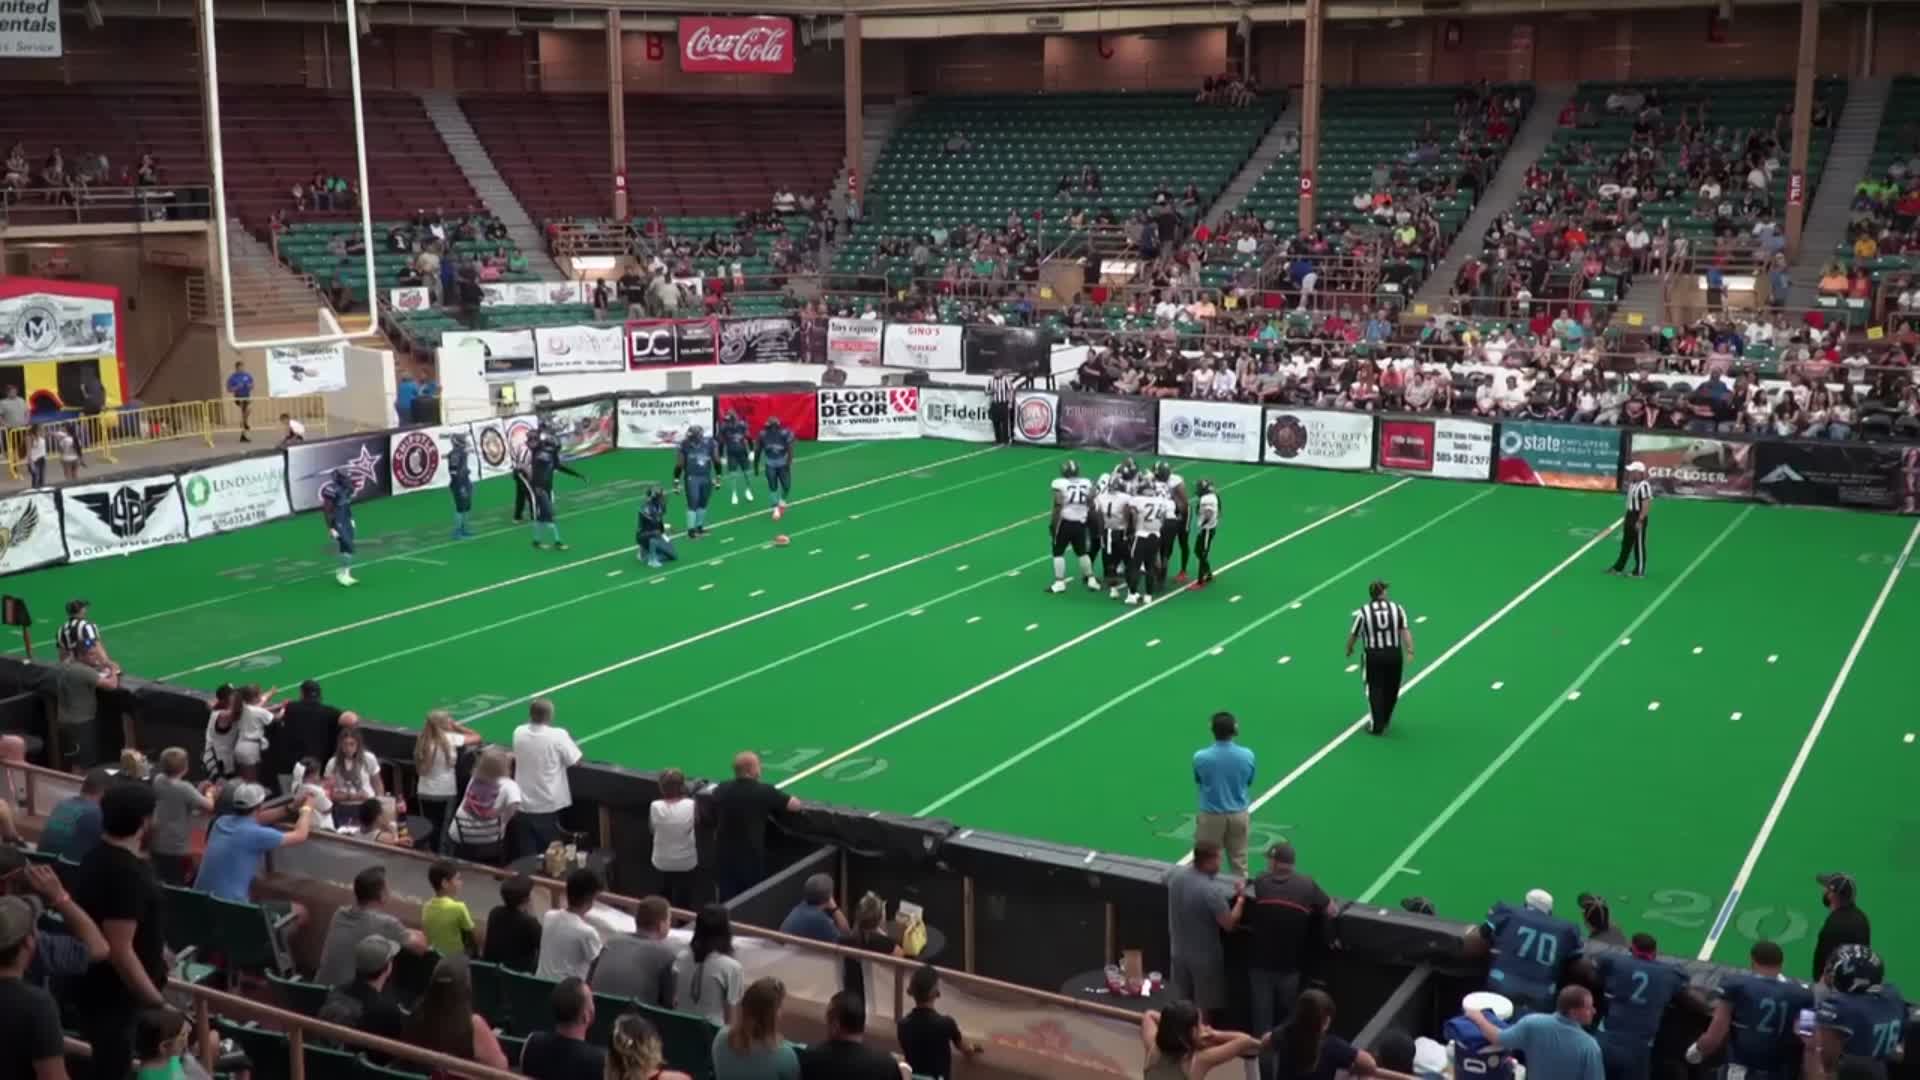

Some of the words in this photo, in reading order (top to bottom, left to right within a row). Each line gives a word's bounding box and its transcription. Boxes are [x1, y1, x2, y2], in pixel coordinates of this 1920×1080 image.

[646, 33, 664, 61] B
[687, 25, 788, 63] Coca-Cola
[1301, 178, 1311, 189] D
[631, 330, 671, 356] DC
[821, 391, 887, 404] FLOOR
[894, 388, 917, 413] &
[821, 404, 888, 417] DECOR
[1194, 418, 1236, 431] Kangen
[1194, 429, 1218, 437] Water
[1221, 431, 1245, 440] Store
[396, 433, 435, 460] CHIPOTLE
[1524, 434, 1560, 452] state
[1648, 466, 1673, 479] GET
[1374, 610, 1389, 629] U
[1642, 889, 1809, 944] 20
[1517, 926, 1557, 966] 70
[1632, 971, 1648, 1004] 2
[1757, 998, 1788, 1033] 21
